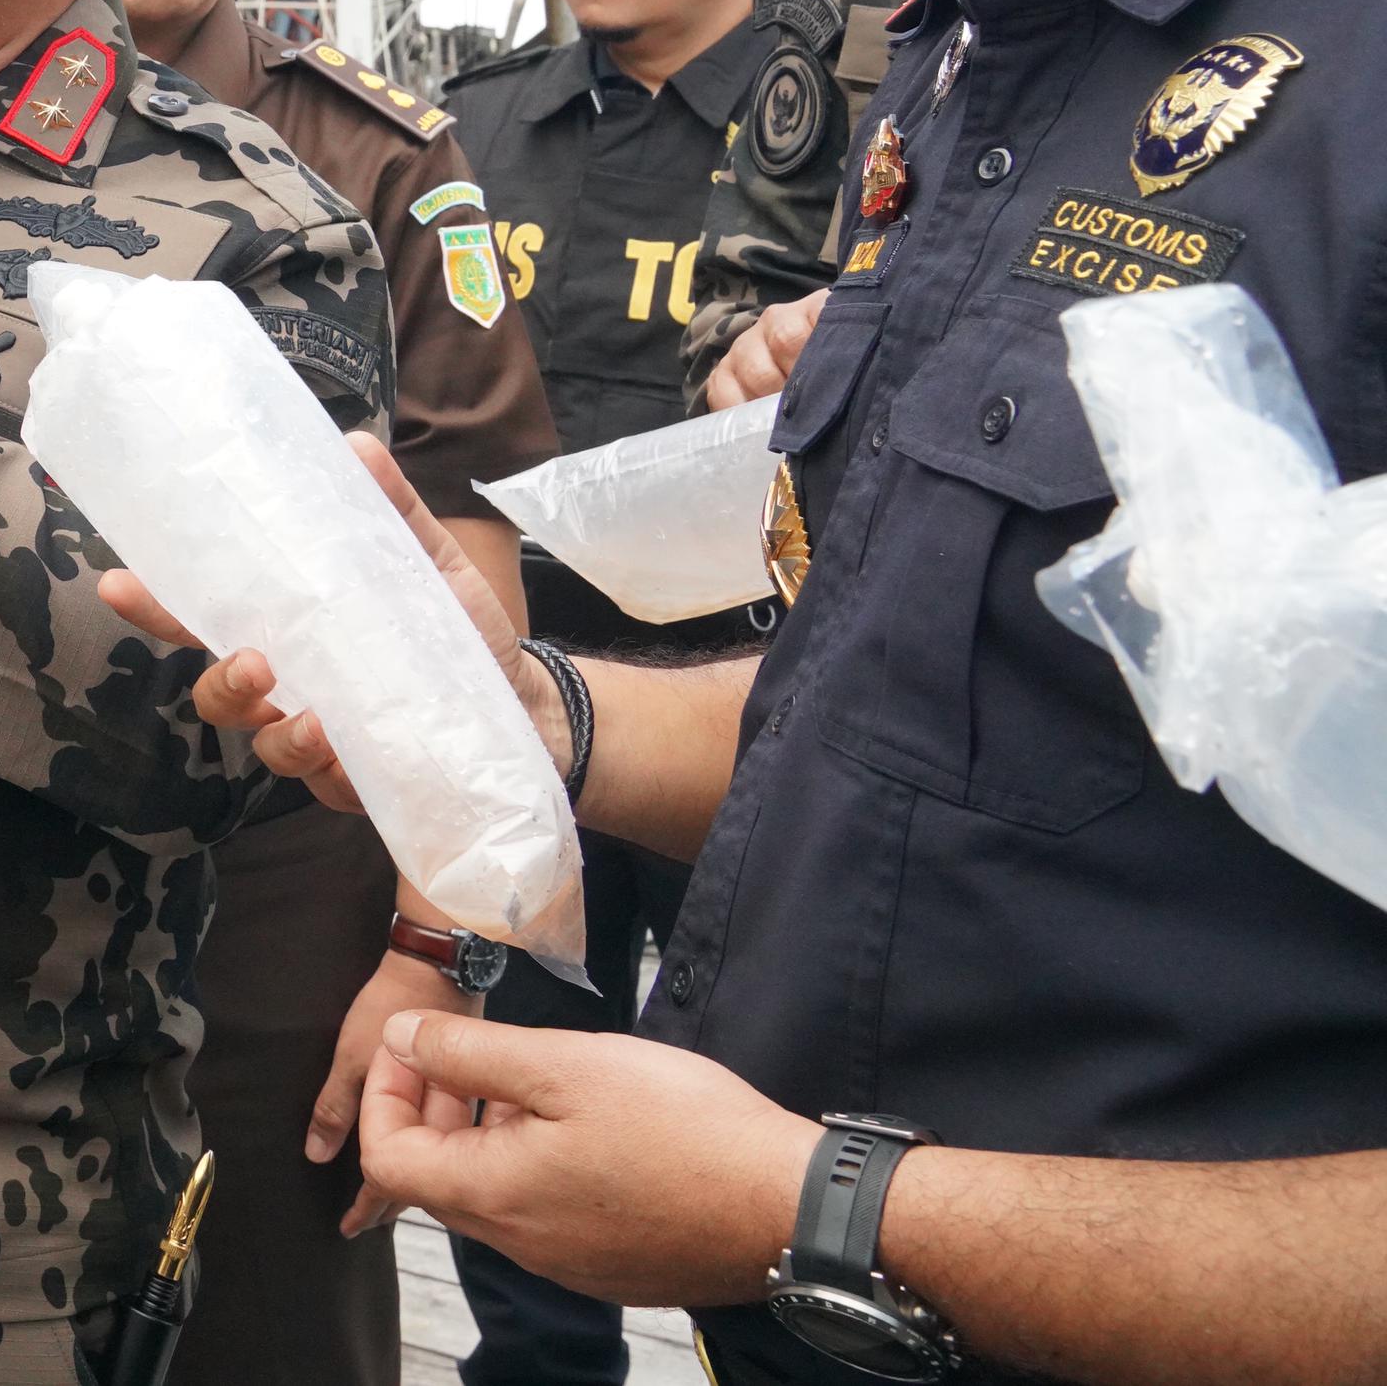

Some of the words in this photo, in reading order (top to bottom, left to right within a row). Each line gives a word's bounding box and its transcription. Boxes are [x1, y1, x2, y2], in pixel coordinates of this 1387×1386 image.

[494, 221, 546, 300] S
[1030, 238, 1181, 294] EXCISE
[1054, 200, 1209, 266] CUSTOMS
